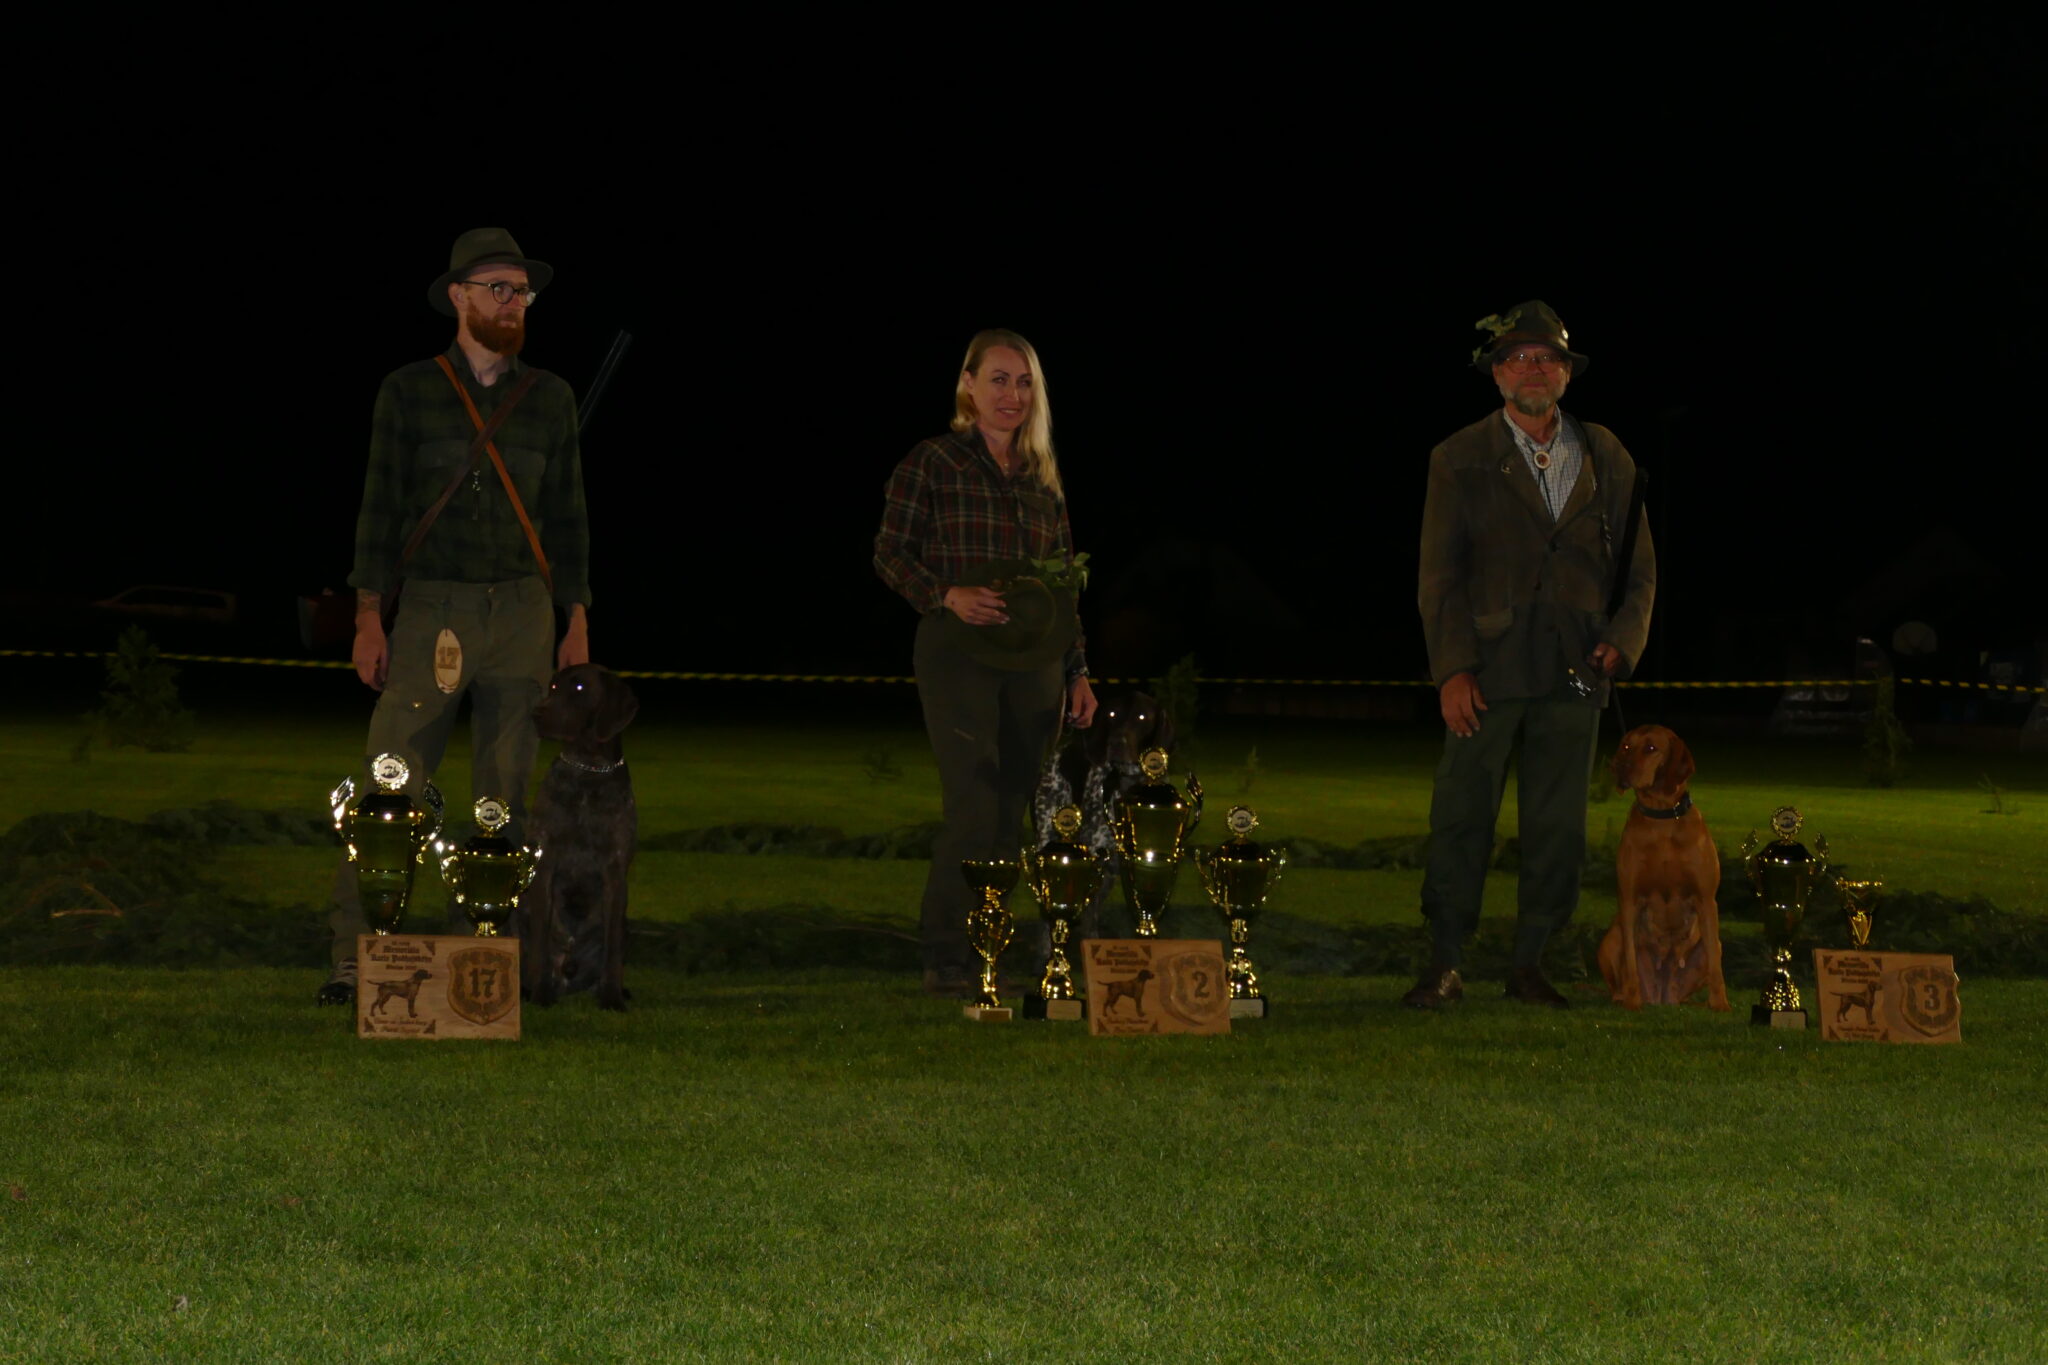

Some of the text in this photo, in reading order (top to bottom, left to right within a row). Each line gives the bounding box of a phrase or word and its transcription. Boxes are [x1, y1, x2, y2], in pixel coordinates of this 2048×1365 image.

[437, 646, 460, 670] 17
[469, 967, 497, 998] 17
[1192, 971, 1210, 998] 2
[1924, 984, 1941, 1010] 3
